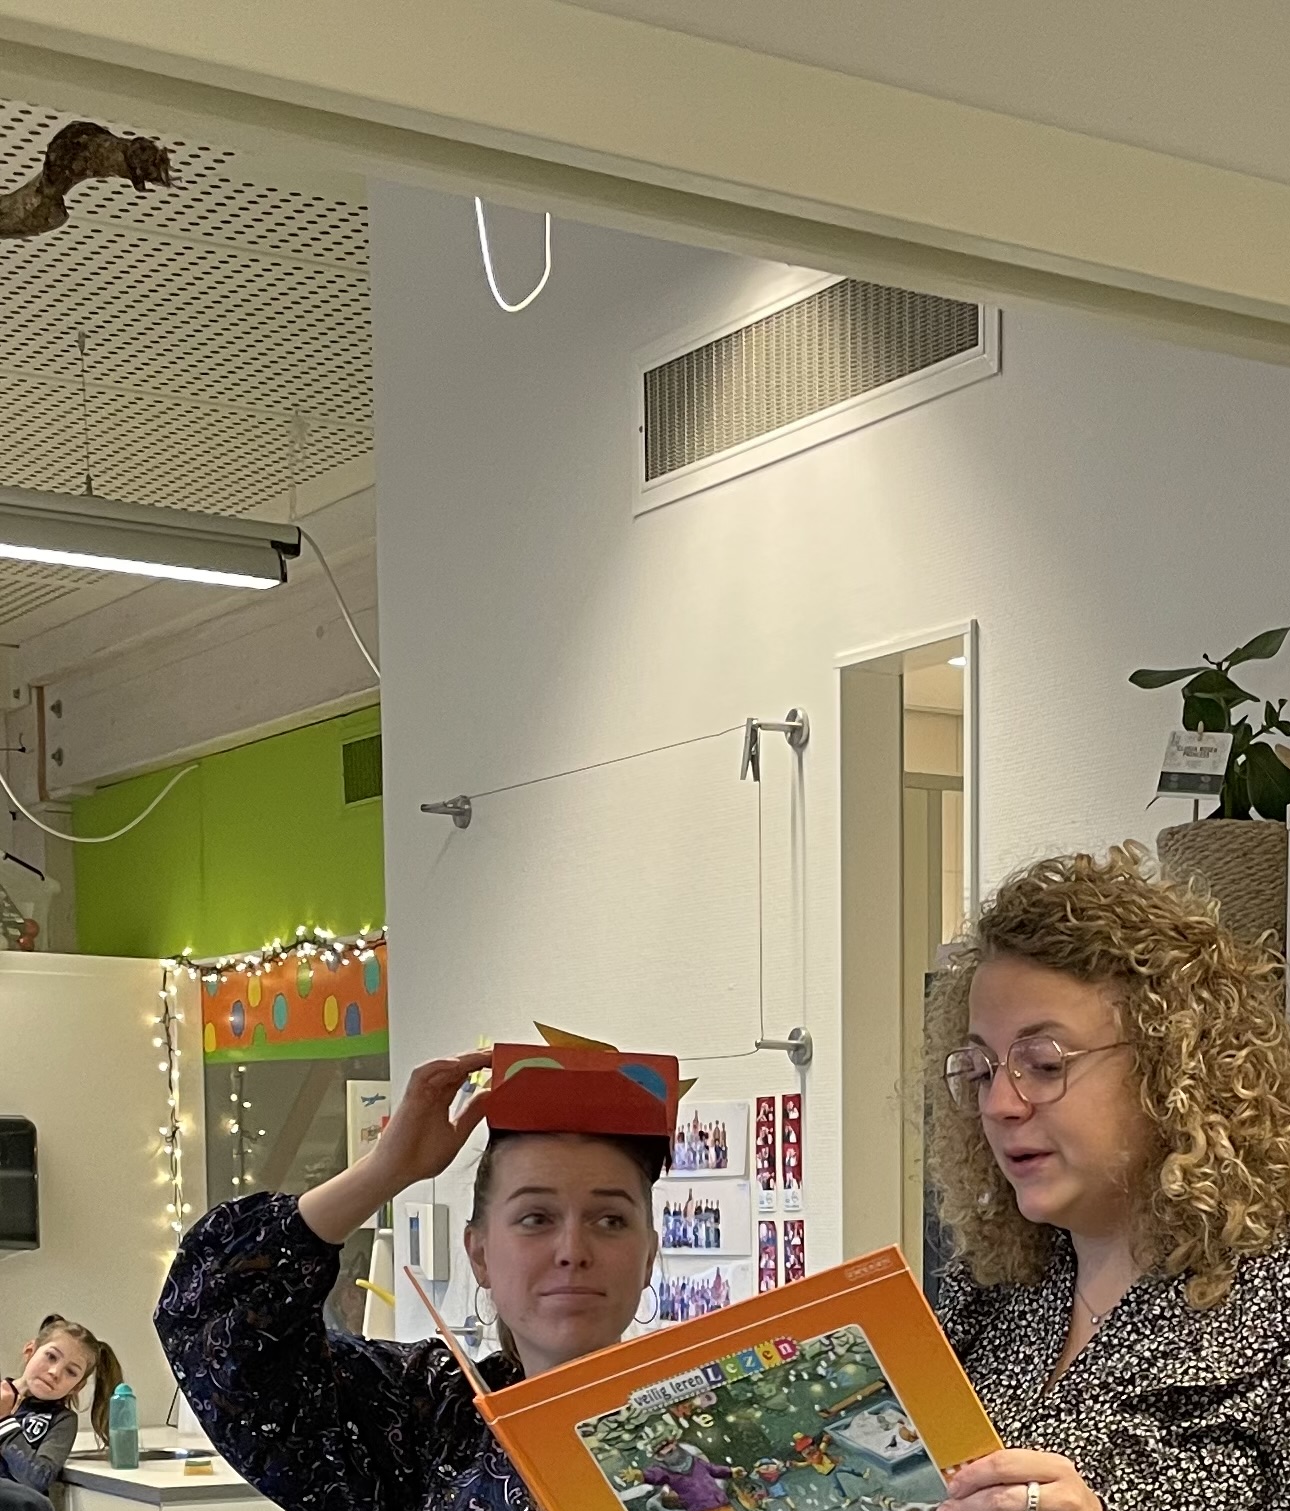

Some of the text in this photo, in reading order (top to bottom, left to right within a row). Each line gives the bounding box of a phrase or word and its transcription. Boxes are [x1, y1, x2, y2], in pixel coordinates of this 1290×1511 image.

[634, 1341, 793, 1407] veilig leren Lezen
[26, 1418, 44, 1435] 76
